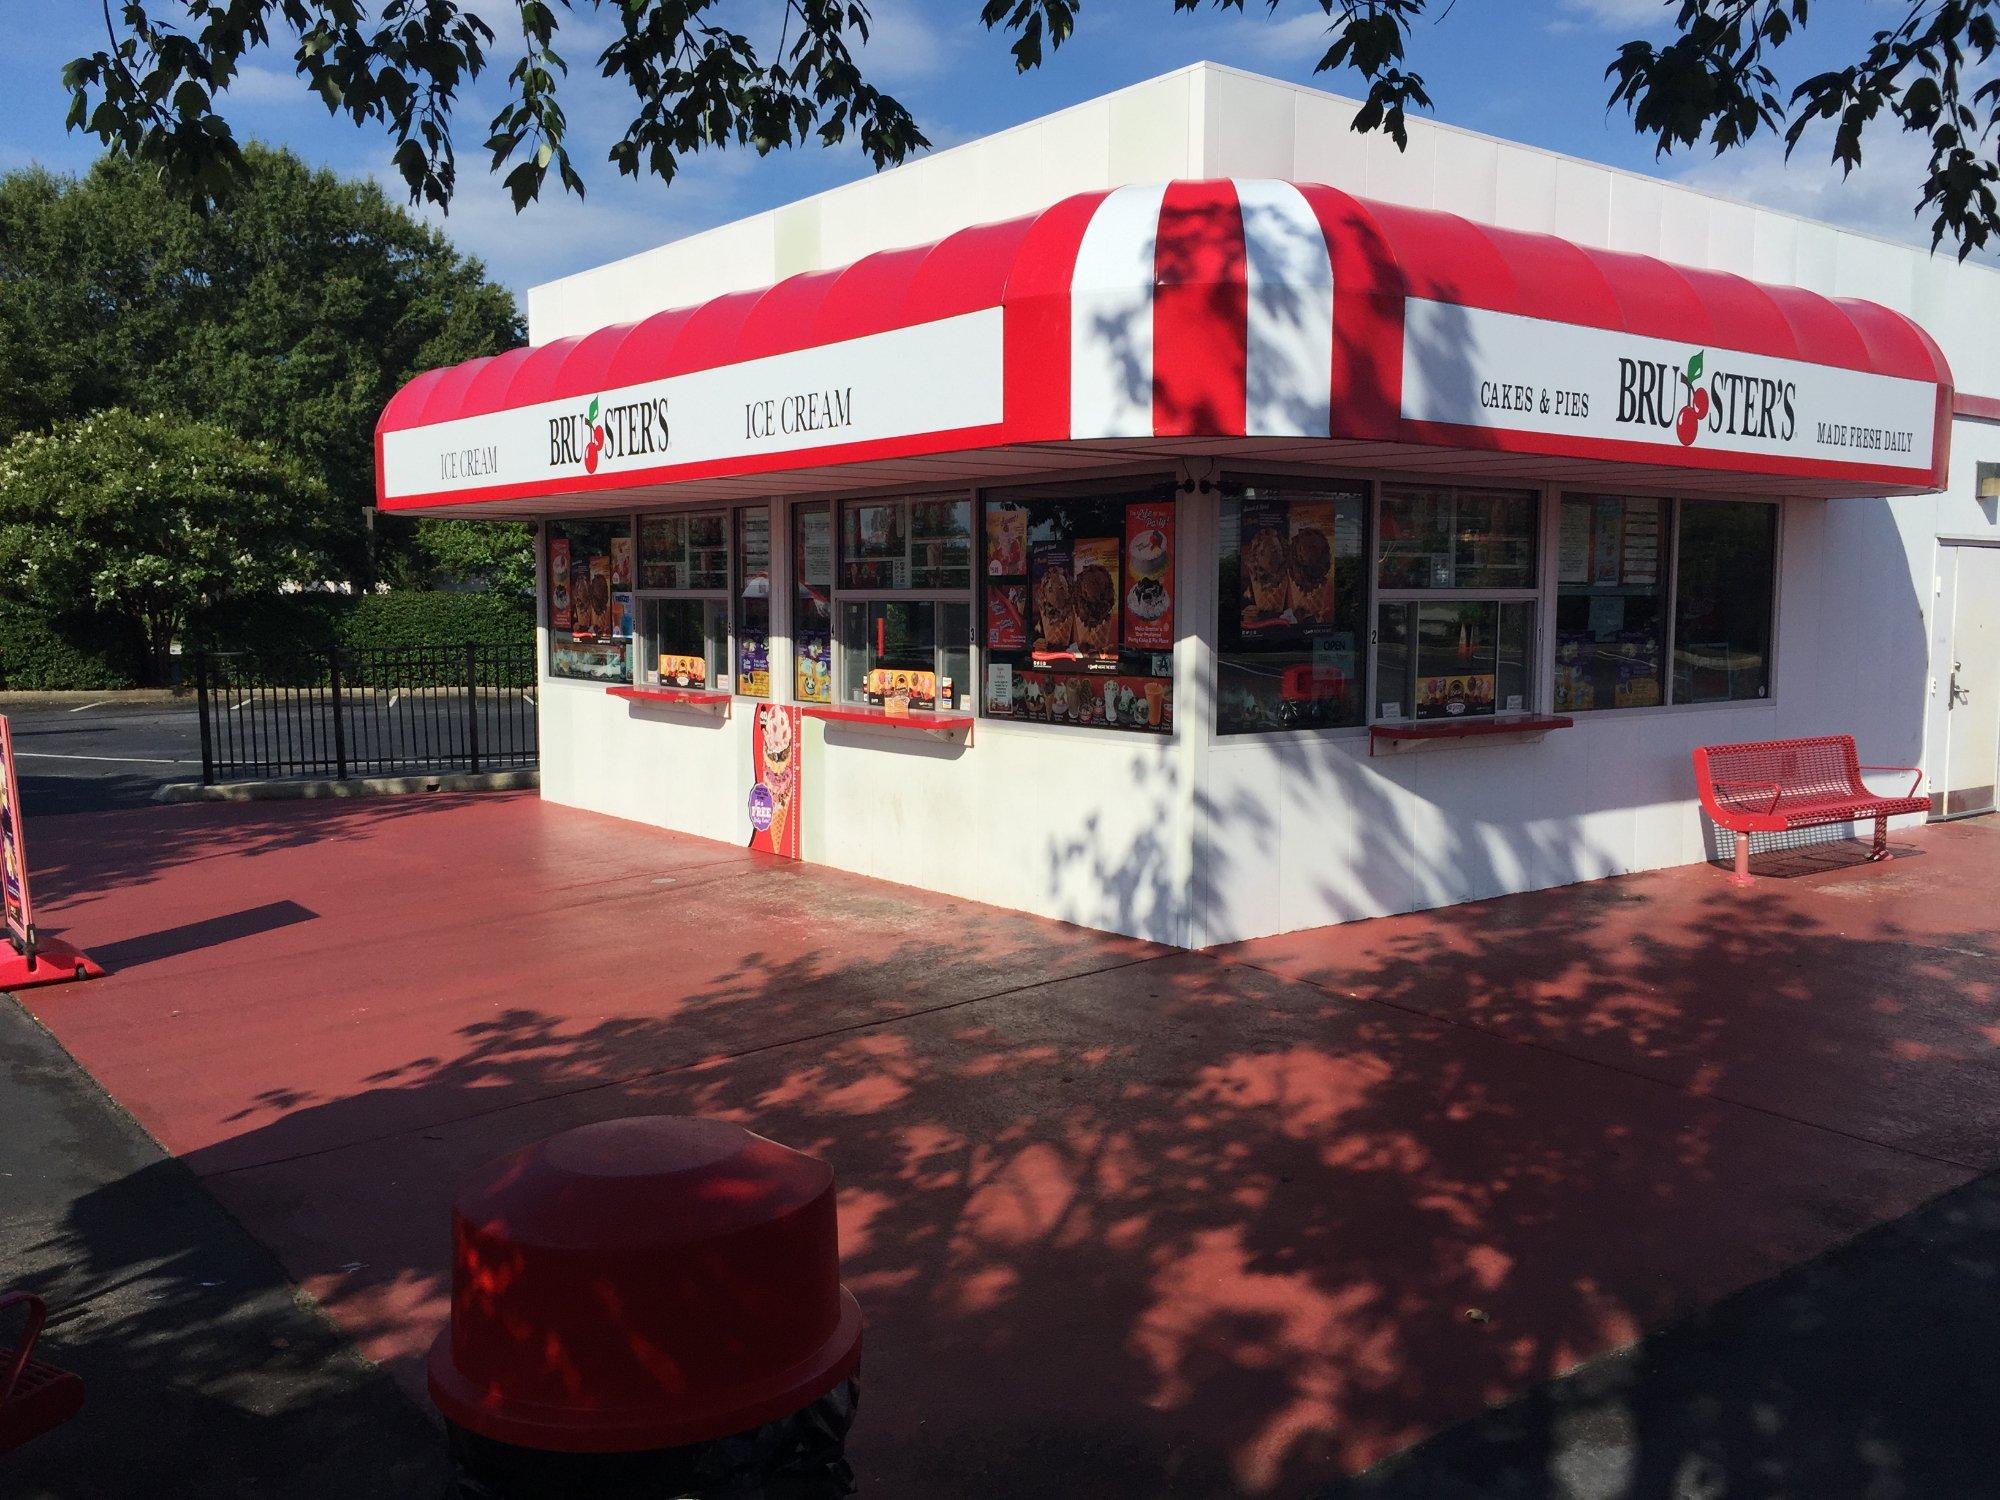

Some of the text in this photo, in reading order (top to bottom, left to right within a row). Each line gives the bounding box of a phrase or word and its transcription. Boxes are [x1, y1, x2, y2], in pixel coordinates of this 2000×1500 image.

[745, 387, 853, 440] ICE CREAM
[1480, 380, 1589, 418] CAKES & PIES
[1615, 357, 1798, 443] BRUSTER'S
[548, 398, 670, 467] BRUSTER'S
[1816, 421, 1914, 454] MADE FRESH DAILY
[440, 446, 498, 480] ICE CREAM
[970, 627, 975, 642] 3
[1371, 630, 1377, 644] 2
[751, 806, 772, 817] FREE
